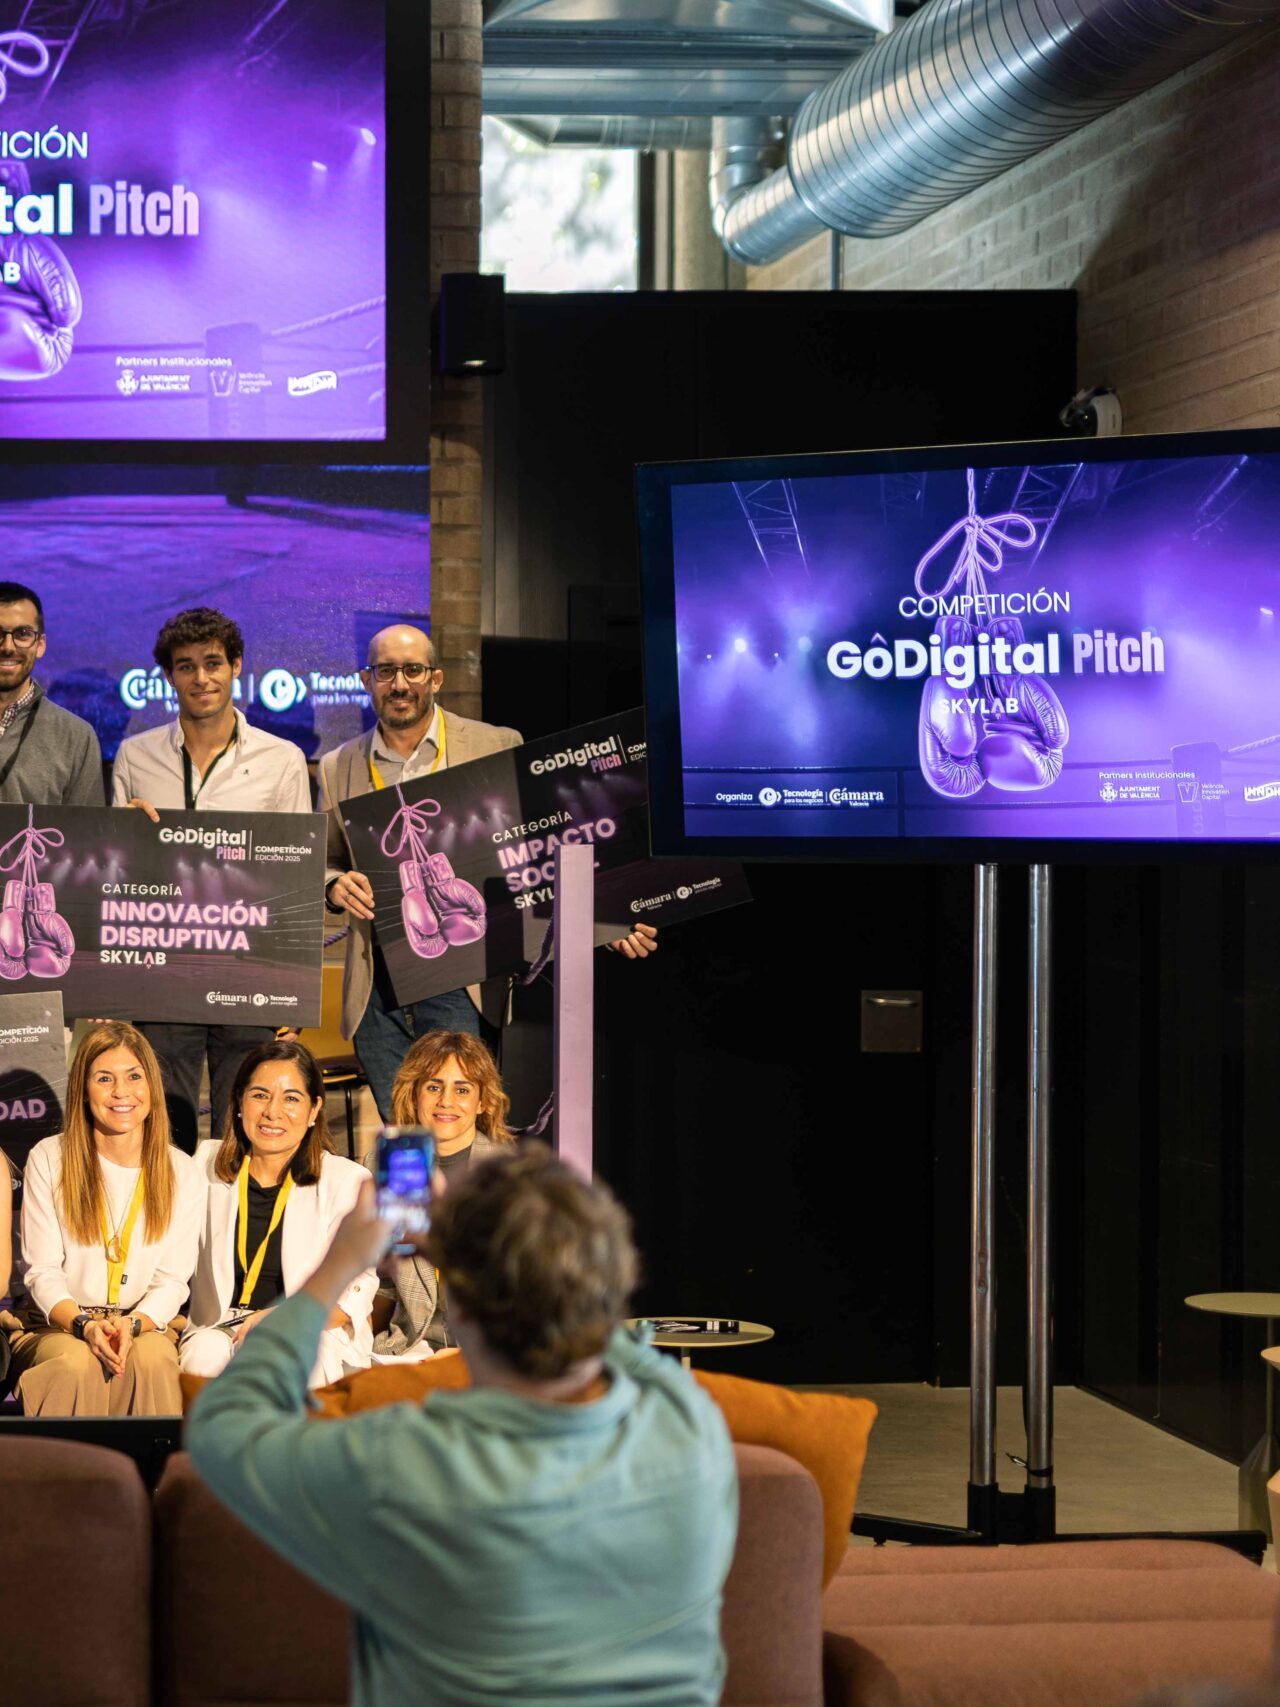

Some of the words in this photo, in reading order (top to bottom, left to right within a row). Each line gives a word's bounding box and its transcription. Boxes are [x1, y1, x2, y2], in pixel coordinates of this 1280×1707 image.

[89, 180, 199, 235] Pitch
[116, 356, 158, 366] Partners
[899, 587, 1071, 618] COMPETICIÓN
[1072, 630, 1164, 674] Pitch
[938, 697, 1019, 719] SKYLAB
[590, 753, 622, 773] Pitch
[1099, 771, 1133, 779] Partners
[1135, 771, 1195, 779] Institucionales
[716, 792, 753, 803] Organiza
[783, 788, 823, 798] Tecnología
[829, 788, 884, 804] Cámara
[492, 811, 573, 843] CATEGORÍA
[255, 845, 312, 856] COMPETICIÓN
[497, 818, 616, 869] IMPACTO
[216, 846, 246, 861] Pitch
[255, 853, 283, 862] EDICIÓN
[102, 883, 182, 896] CATEGORÍA
[514, 887, 555, 909] SKYL
[630, 893, 671, 912] Cámara
[101, 899, 268, 926] INNOVACIÓN
[100, 925, 250, 951] DISRUPTIVA
[100, 950, 167, 968] SKYLAB
[206, 991, 247, 1004] Cámara
